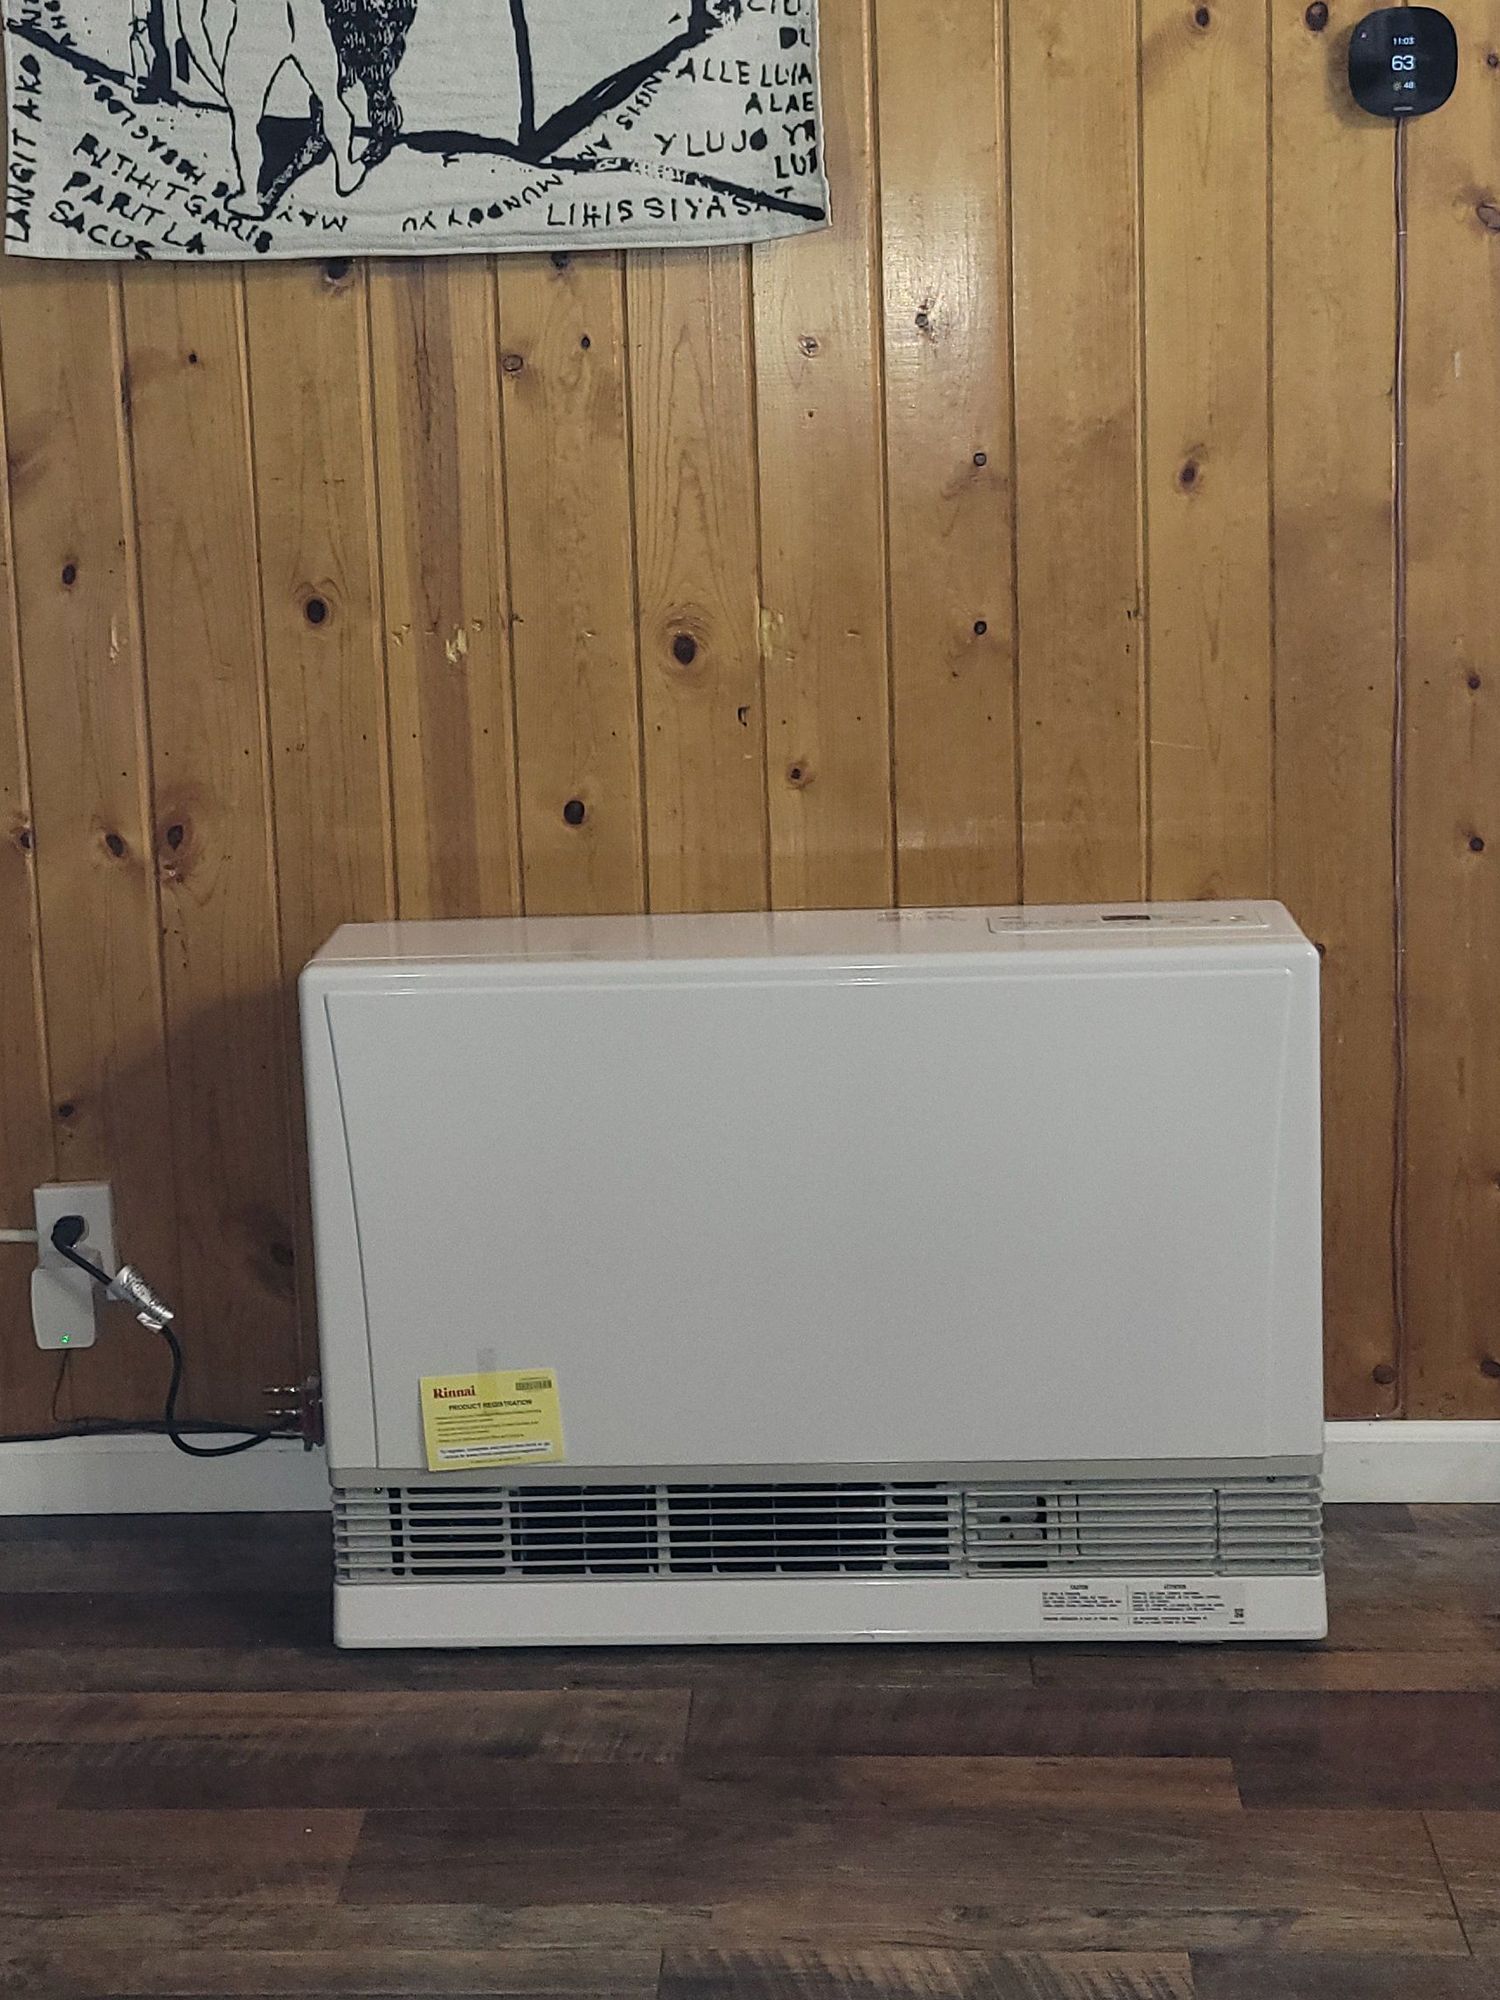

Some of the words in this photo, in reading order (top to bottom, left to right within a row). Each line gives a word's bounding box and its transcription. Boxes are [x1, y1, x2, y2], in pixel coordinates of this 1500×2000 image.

[1393, 37, 1415, 45] 11:03
[1391, 55, 1416, 71] 63
[433, 1385, 476, 1399] Rinnai
[448, 1402, 481, 1411] PRODUCT
[483, 1399, 532, 1409] REGISTRATION
